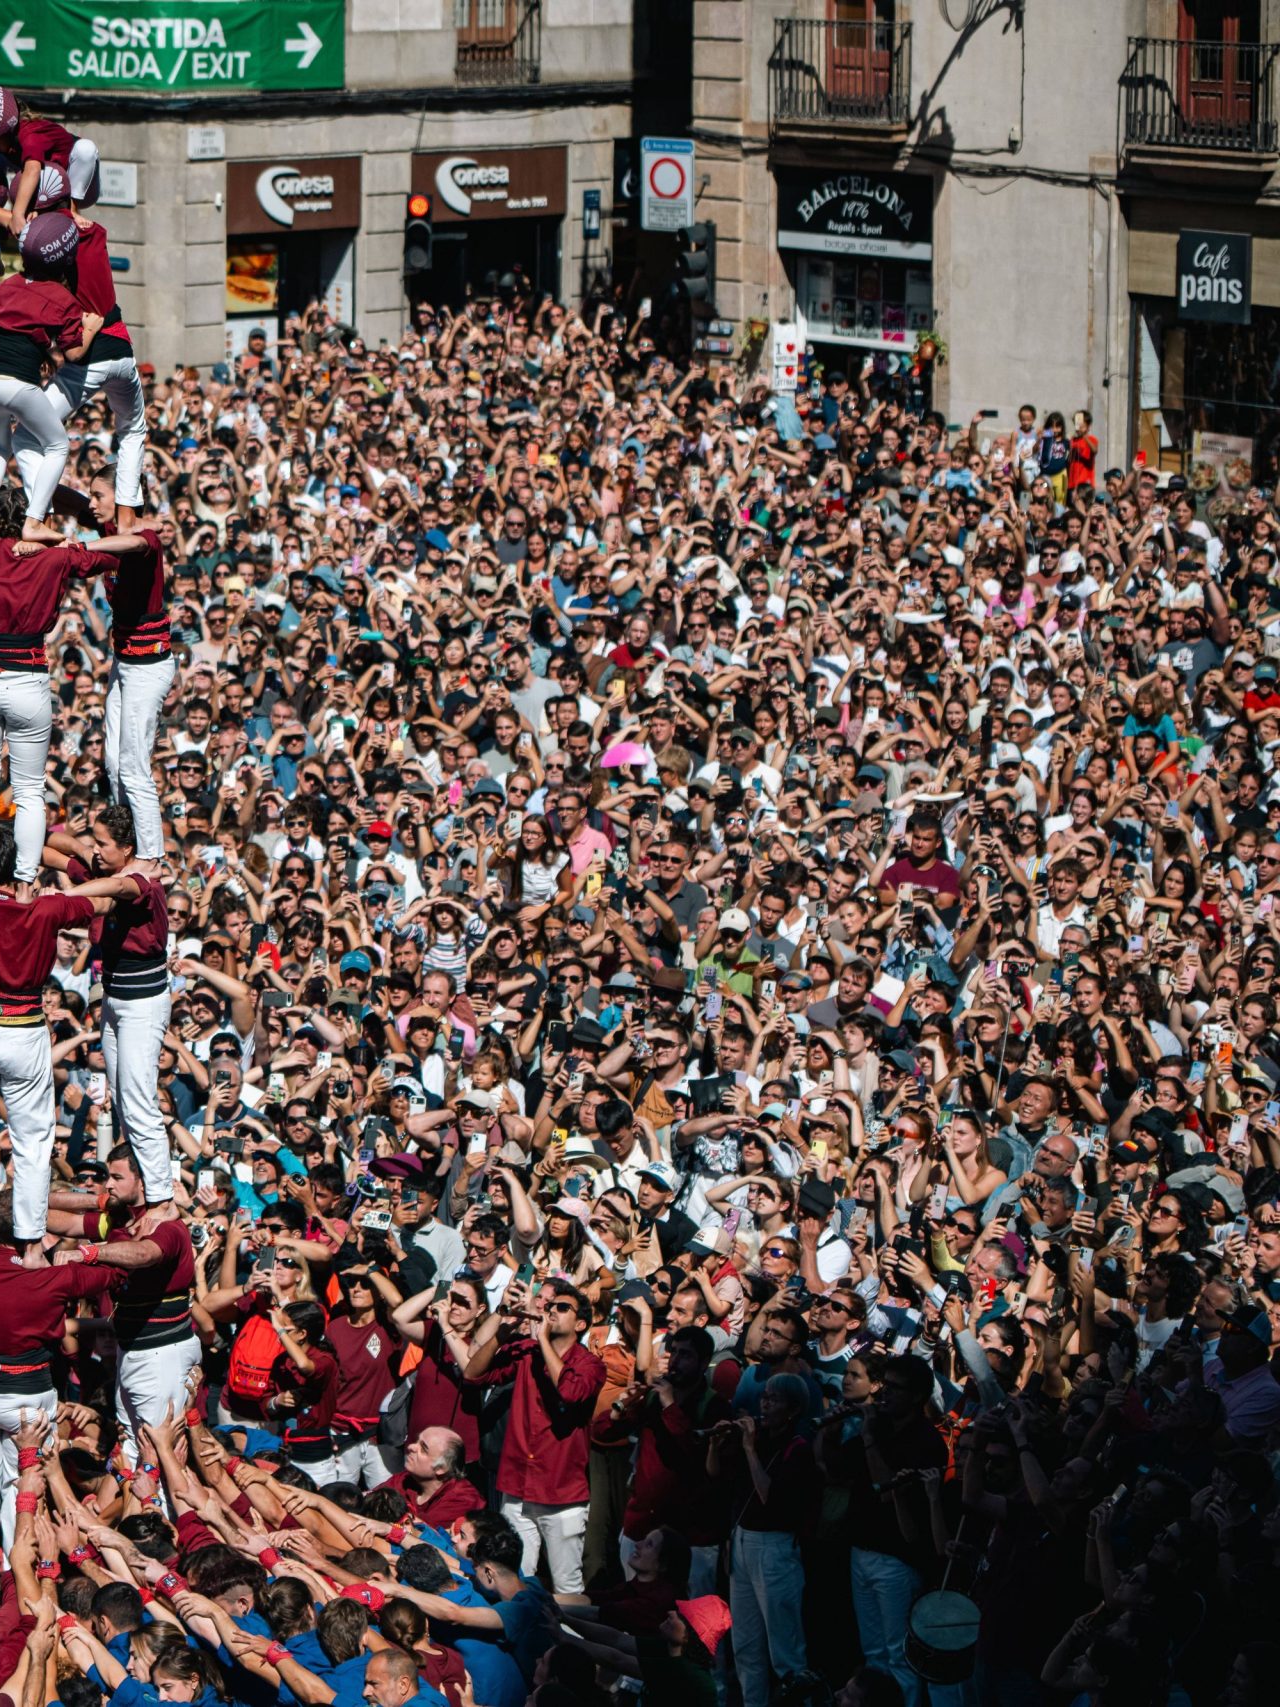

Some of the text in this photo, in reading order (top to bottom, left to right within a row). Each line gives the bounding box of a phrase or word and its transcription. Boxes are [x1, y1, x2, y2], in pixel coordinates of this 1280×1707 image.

[91, 16, 227, 49] SORTIDA
[67, 49, 163, 80] SALIDA
[192, 51, 252, 80] EXIT
[256, 164, 335, 227] Conesa
[436, 156, 509, 218] Conesa
[797, 176, 913, 231] BARCELONA
[841, 201, 870, 219] 1976
[861, 223, 883, 235] Sport
[40, 239, 61, 255] SOM
[1181, 274, 1243, 308] pans
